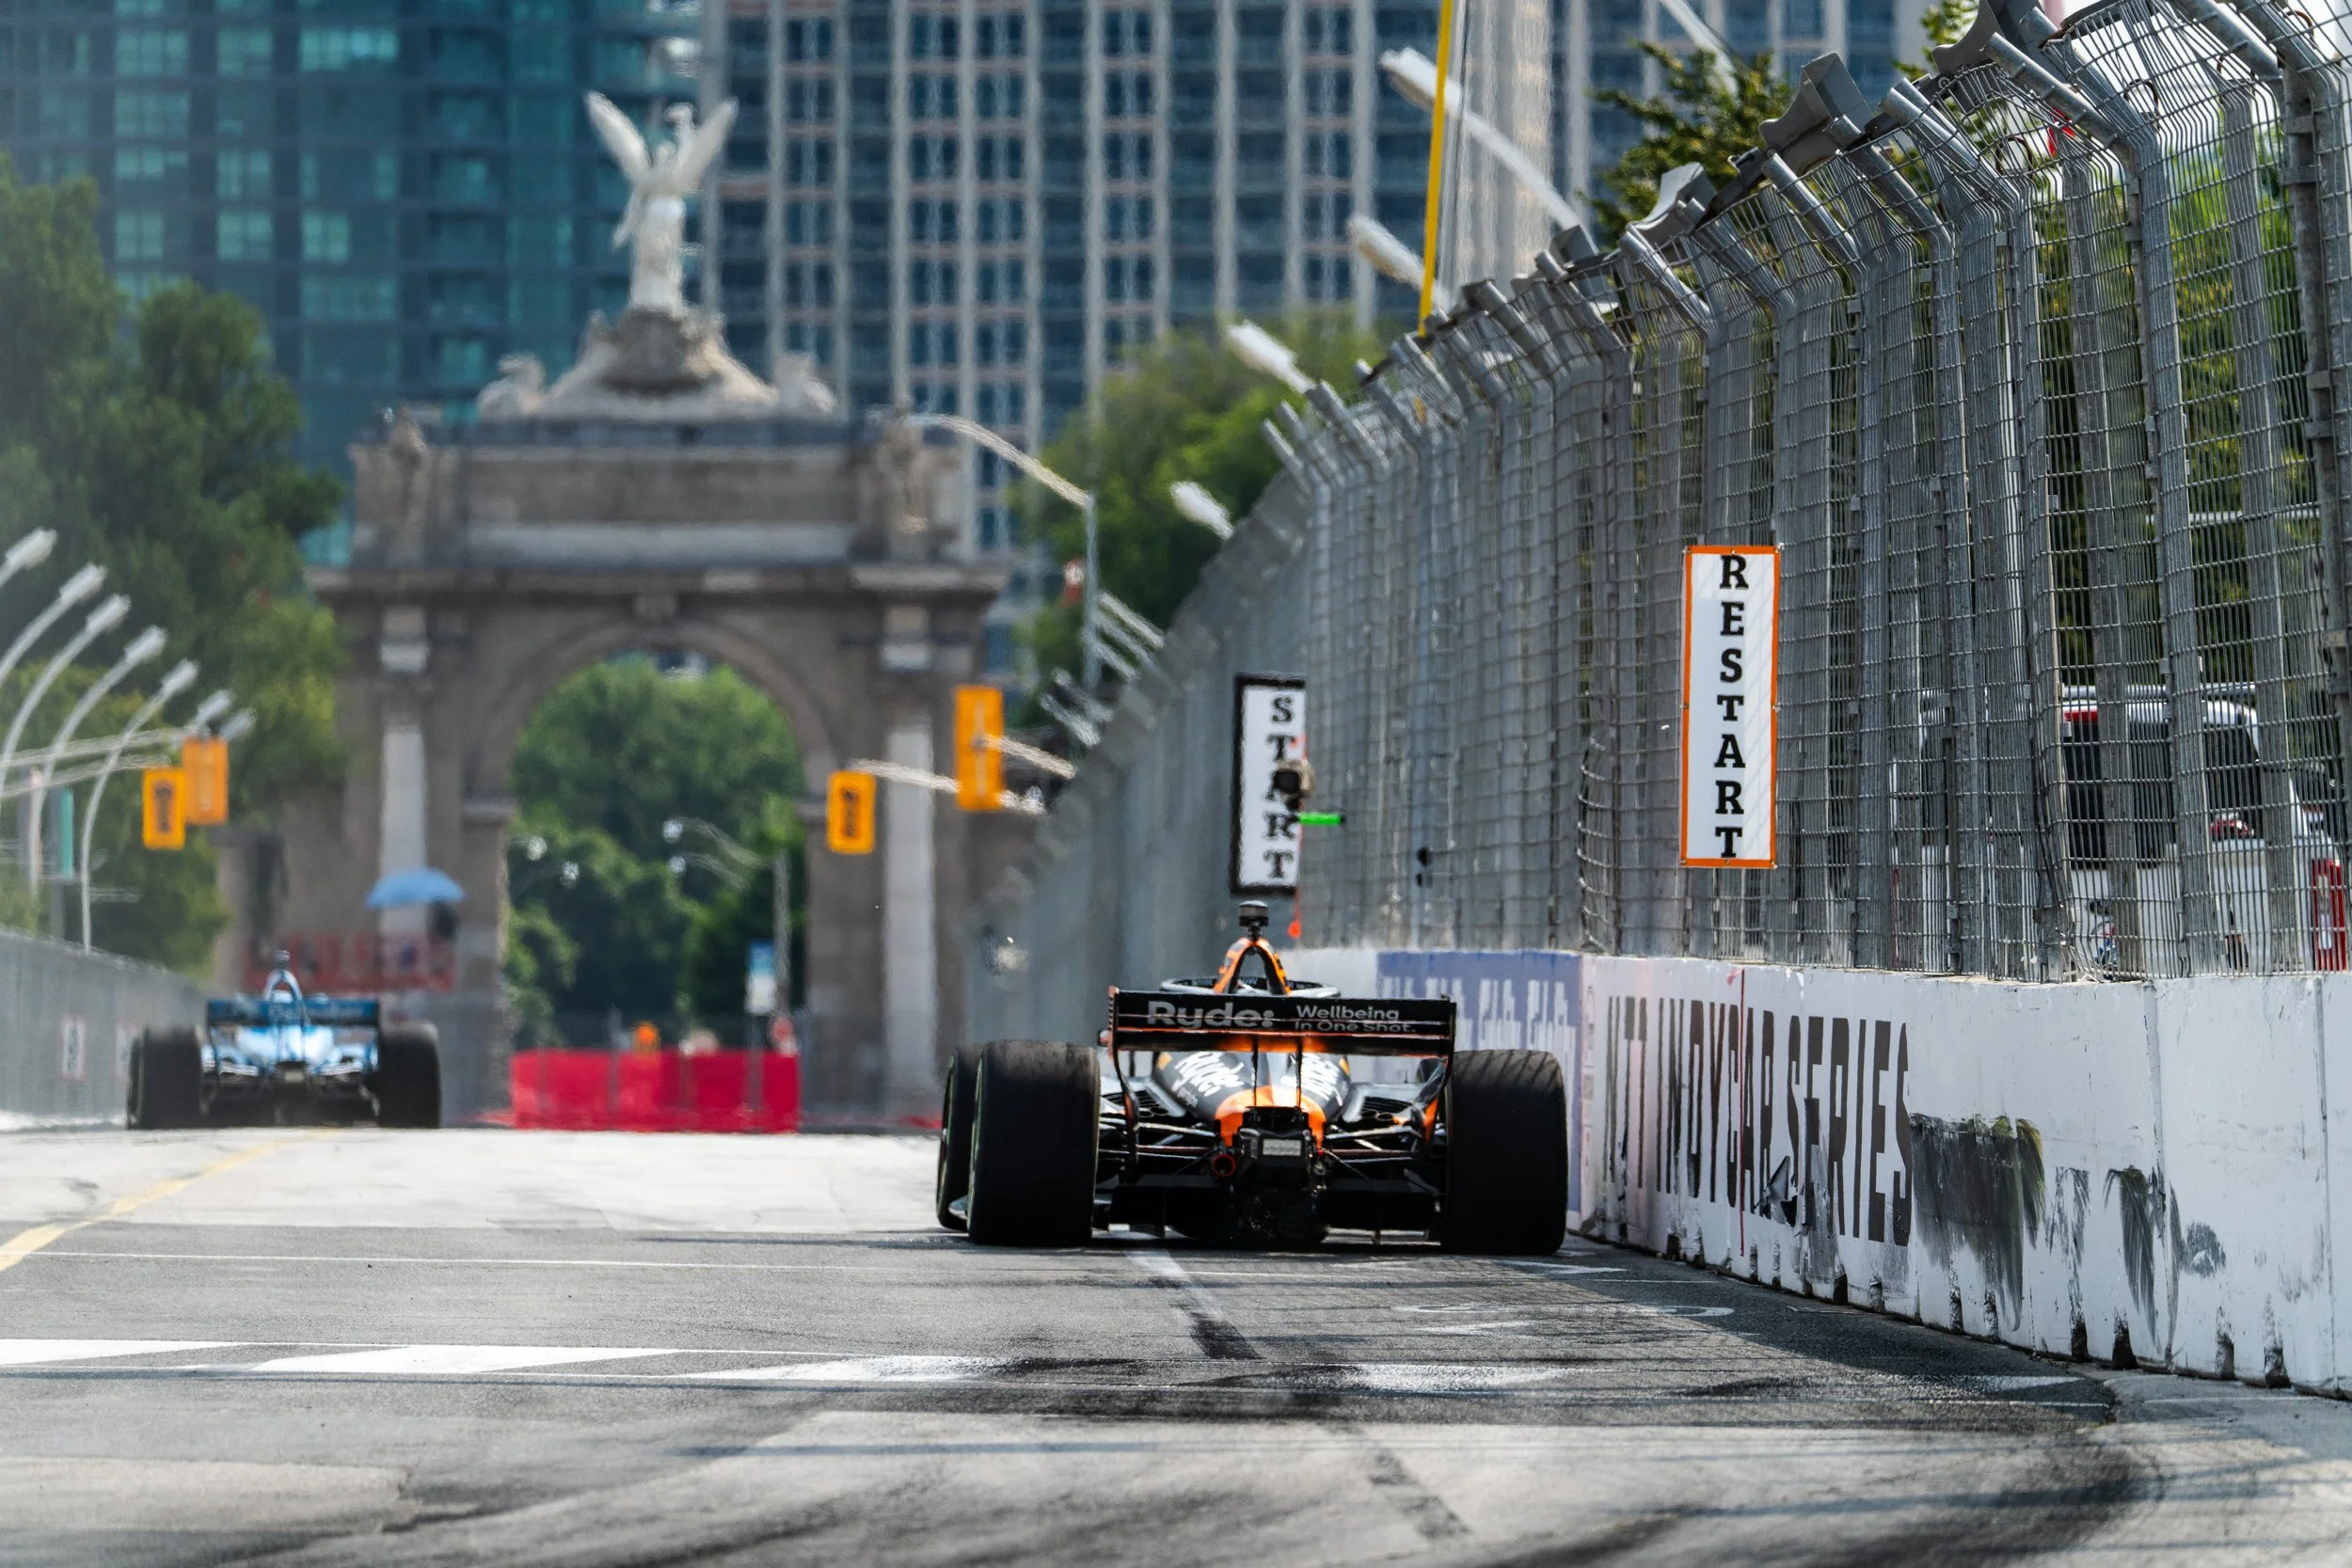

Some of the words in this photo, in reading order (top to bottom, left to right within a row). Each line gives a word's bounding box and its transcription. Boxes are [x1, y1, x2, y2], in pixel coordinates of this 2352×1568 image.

[1713, 554, 1749, 859] RESTART
[1146, 1000, 1276, 1030] Ryde:
[1295, 1004, 1400, 1022] Wellbeing
[1295, 1021, 1312, 1031] In
[1317, 1020, 1359, 1032] One
[1362, 1022, 1417, 1033] Shot.
[1602, 995, 1648, 1190] NTT
[1656, 997, 1774, 1221] INDYCAR
[1787, 1014, 1914, 1247] SERIES
